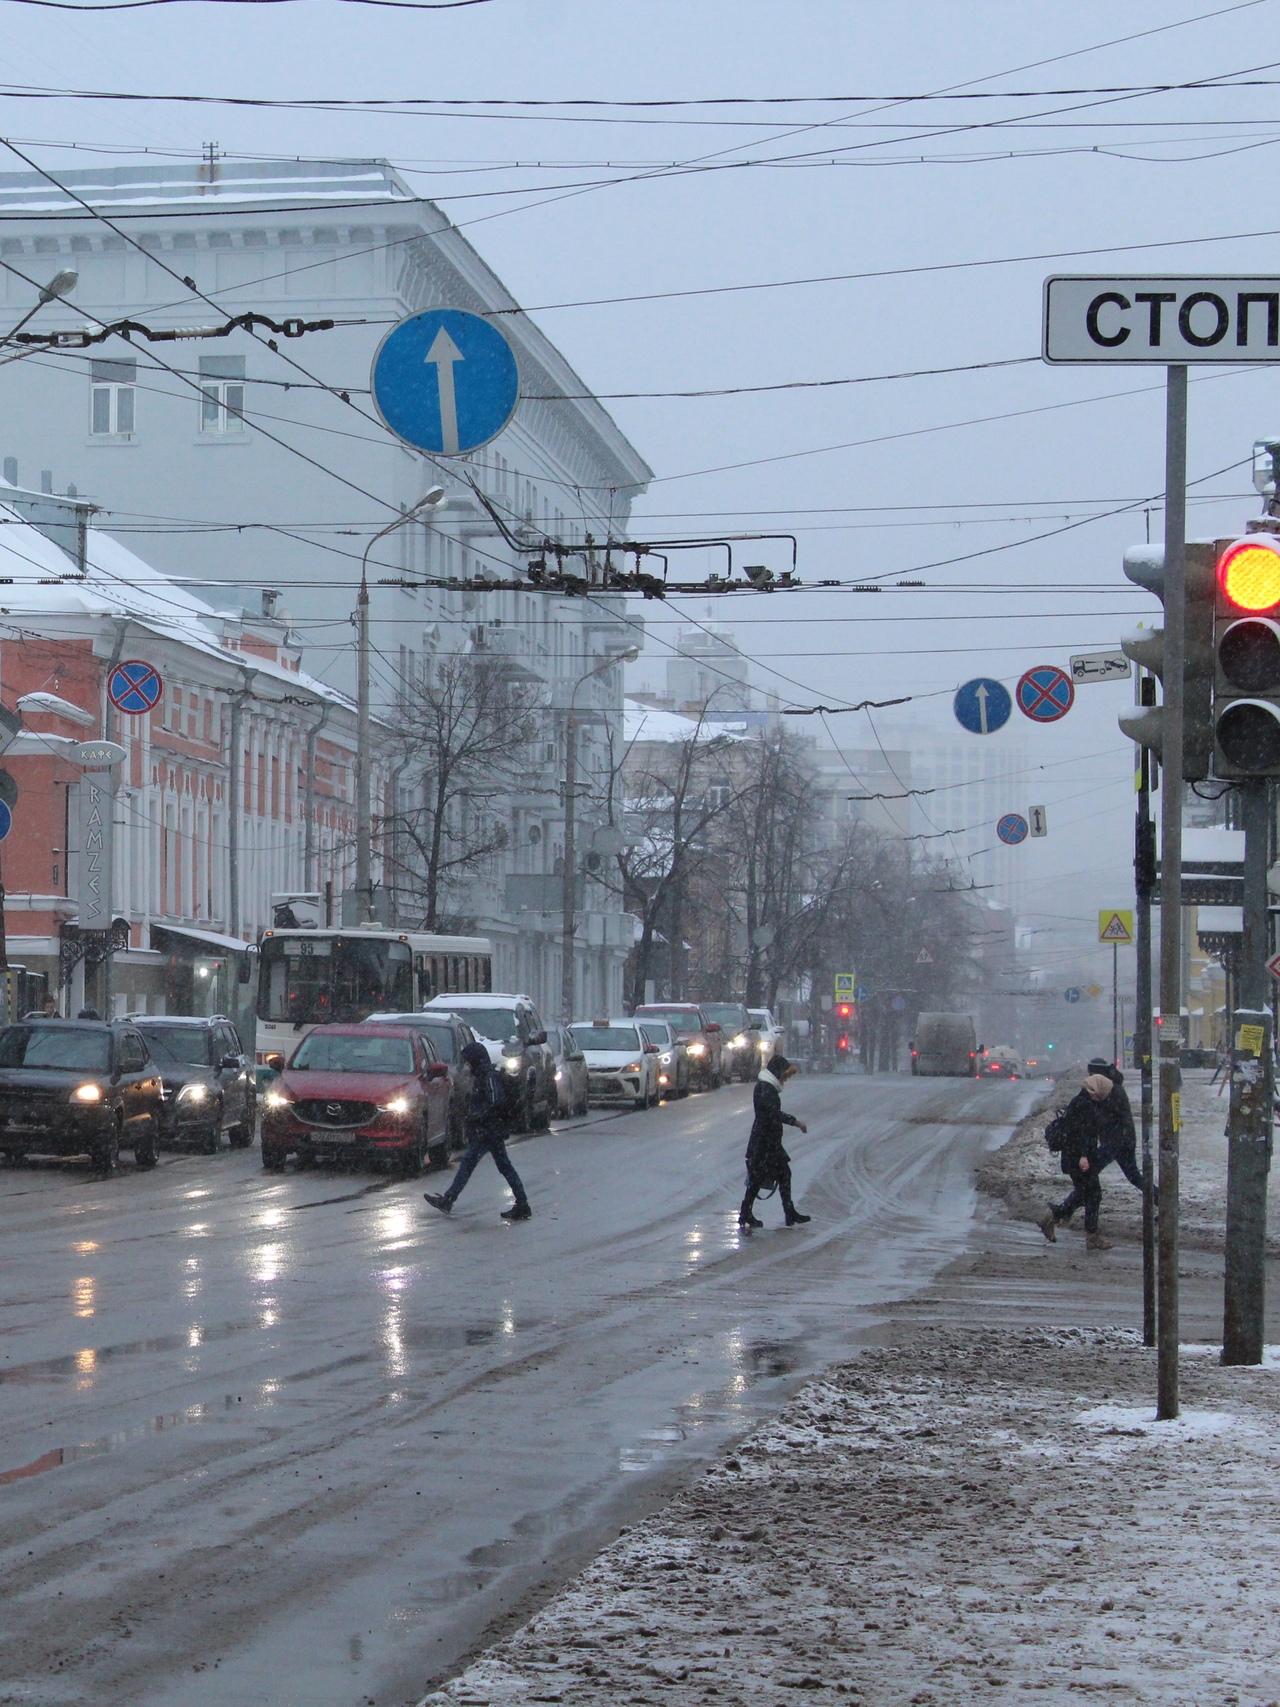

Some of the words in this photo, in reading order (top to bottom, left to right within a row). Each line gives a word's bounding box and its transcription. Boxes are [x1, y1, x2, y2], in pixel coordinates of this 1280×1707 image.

[1086, 292, 1279, 347] СТОП
[81, 749, 112, 760] КАФЕ
[86, 783, 103, 920] RAMZES
[300, 943, 314, 955] 95
